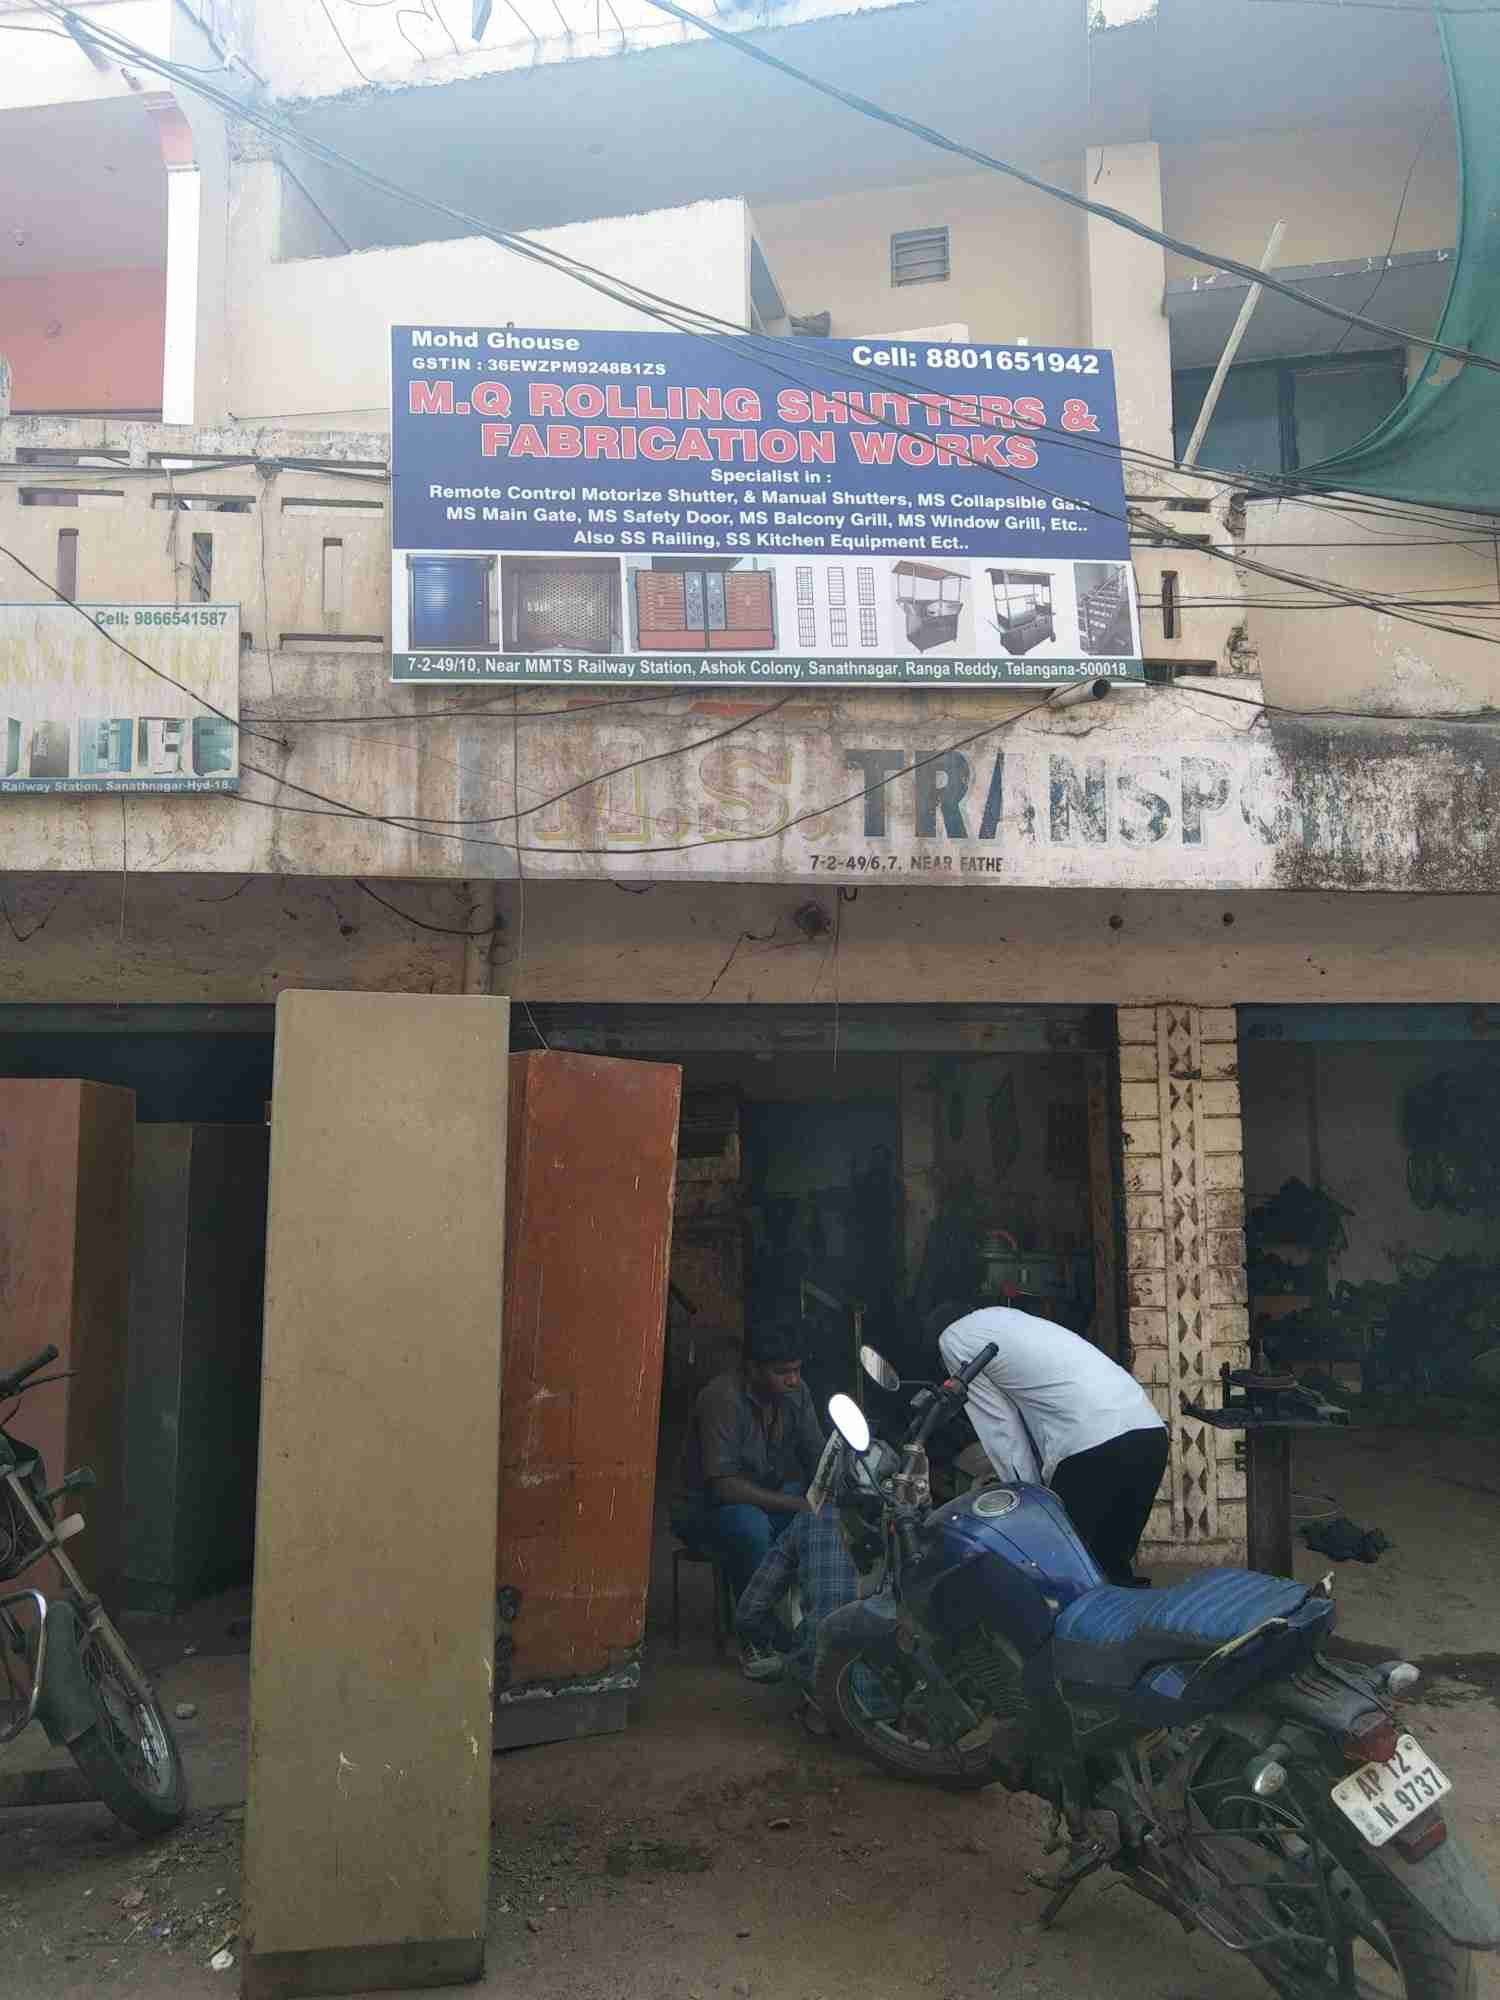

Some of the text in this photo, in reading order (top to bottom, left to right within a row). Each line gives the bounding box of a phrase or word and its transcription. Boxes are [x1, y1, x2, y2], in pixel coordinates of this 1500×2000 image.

[411, 330, 580, 351] Mohd Ghouse
[412, 357, 471, 370] GSTIN
[852, 346, 1100, 374] Cell: 8801651942
[408, 380, 1100, 432] M.Q ROLLING SHUTTERS &
[481, 422, 1039, 469] FABRICATION WORKS
[711, 468, 799, 485] Specialist
[805, 470, 821, 483] in
[429, 484, 501, 500] Remote
[507, 486, 576, 501] Control
[582, 487, 662, 502] Motorize
[667, 488, 738, 505] Shutter,
[743, 489, 756, 503] &
[762, 490, 827, 505] Manual
[832, 491, 913, 508] Shutters,
[918, 493, 945, 507] MS
[951, 493, 1047, 512] Collapsible
[446, 506, 1088, 532] MS Main Gate, MS Safety Door, MS Balcony Grill, MS Window Grill, Etc..
[573, 530, 969, 550] Also SS Railing, SS Kitchen Equipment Ect..
[96, 611, 227, 626] Cell: 9866541587
[407, 656, 481, 674] 7-2-49/10,
[485, 657, 520, 673] Near
[525, 658, 573, 673] MMTS
[578, 659, 635, 677] Railway
[640, 659, 696, 676] Station,
[700, 660, 746, 674] Ashok
[750, 660, 804, 678] Colony,
[808, 660, 901, 679] Sanathnagar,
[906, 661, 952, 679] Ranga
[954, 662, 1001, 679] Reddy,
[1, 781, 50, 794] Railway
[910, 855, 952, 872] NEAR
[1356, 1767, 1384, 1801] AP
[1373, 1802, 1399, 1829] N
[1394, 1766, 1443, 1812] 9737
